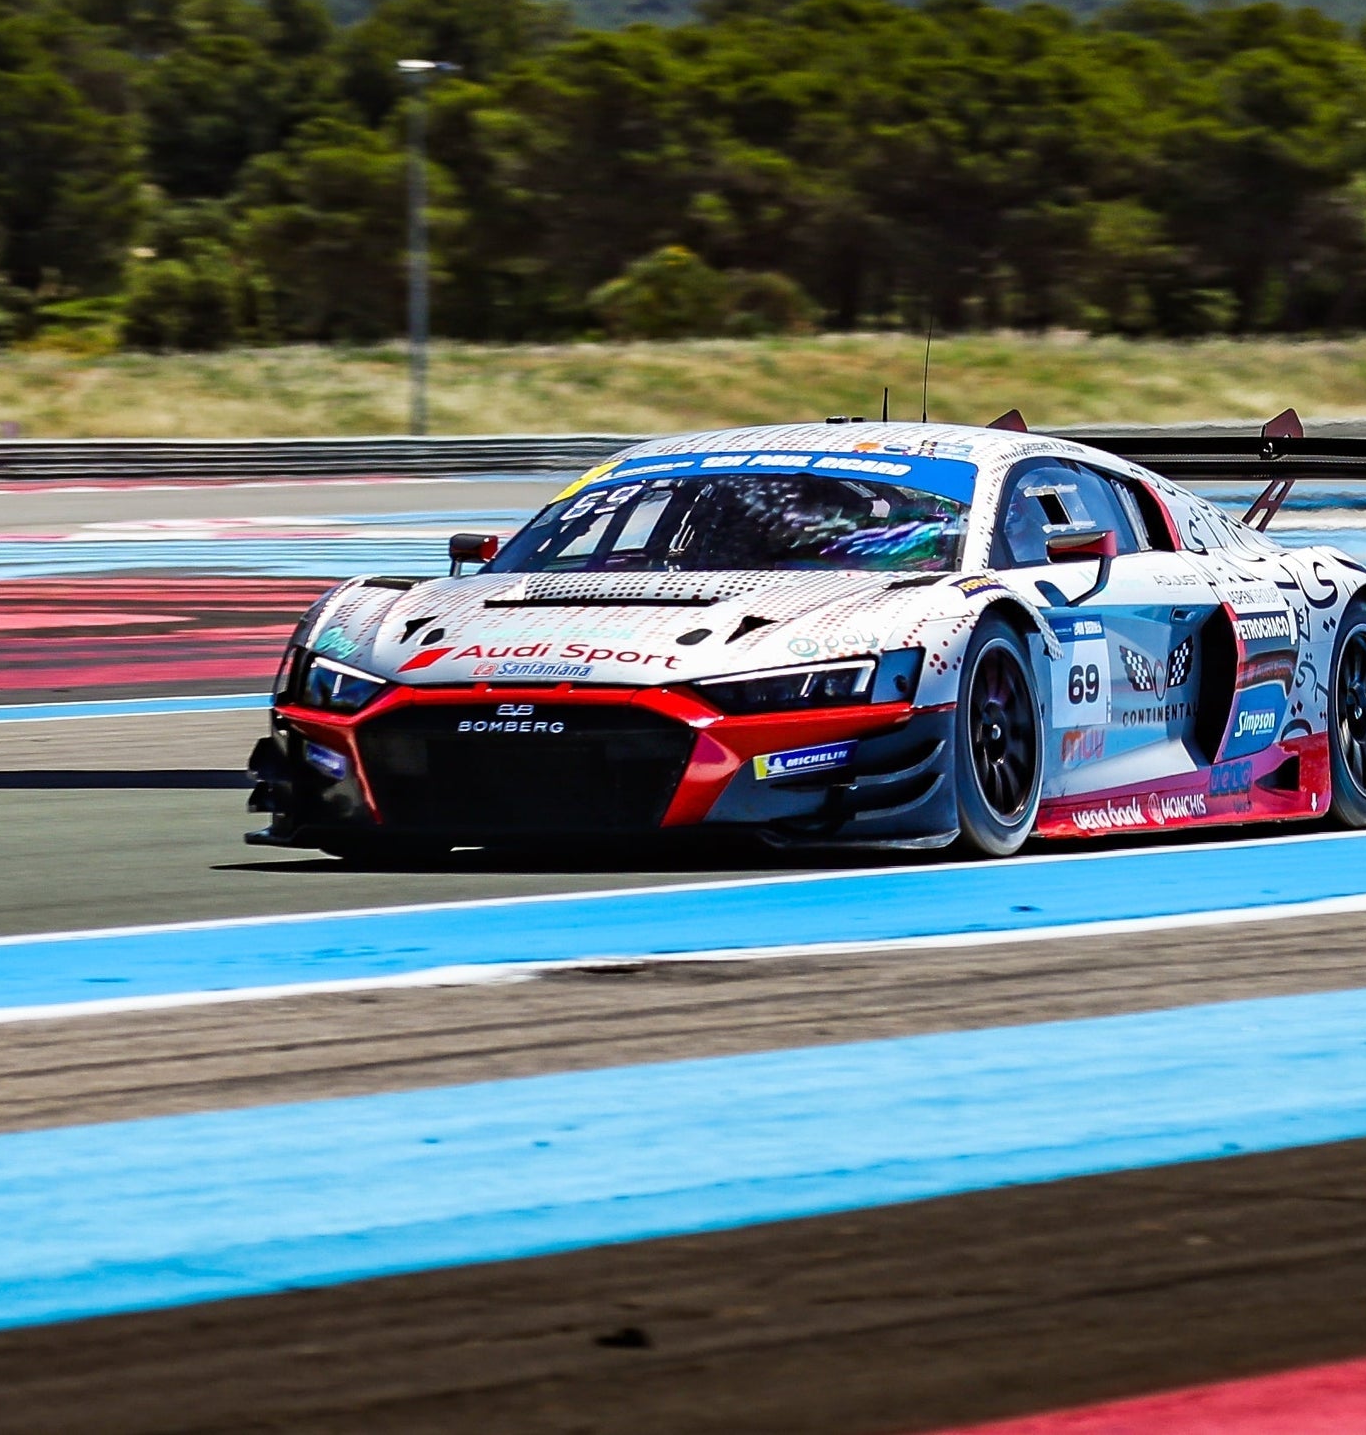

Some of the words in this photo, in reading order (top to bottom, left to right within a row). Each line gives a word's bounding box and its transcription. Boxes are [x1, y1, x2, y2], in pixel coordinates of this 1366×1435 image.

[812, 456, 912, 477] RICARD
[560, 484, 644, 521] 69
[1233, 615, 1290, 641] PETROCHACO
[452, 643, 552, 660] Audi
[560, 643, 682, 670] Sport
[471, 664, 495, 677] La
[1068, 664, 1100, 705] 69
[457, 720, 565, 734] BOMBERG
[1122, 702, 1198, 727] CONTINENTAL
[1234, 711, 1276, 738] Simpson
[786, 750, 848, 768] MICHELIN
